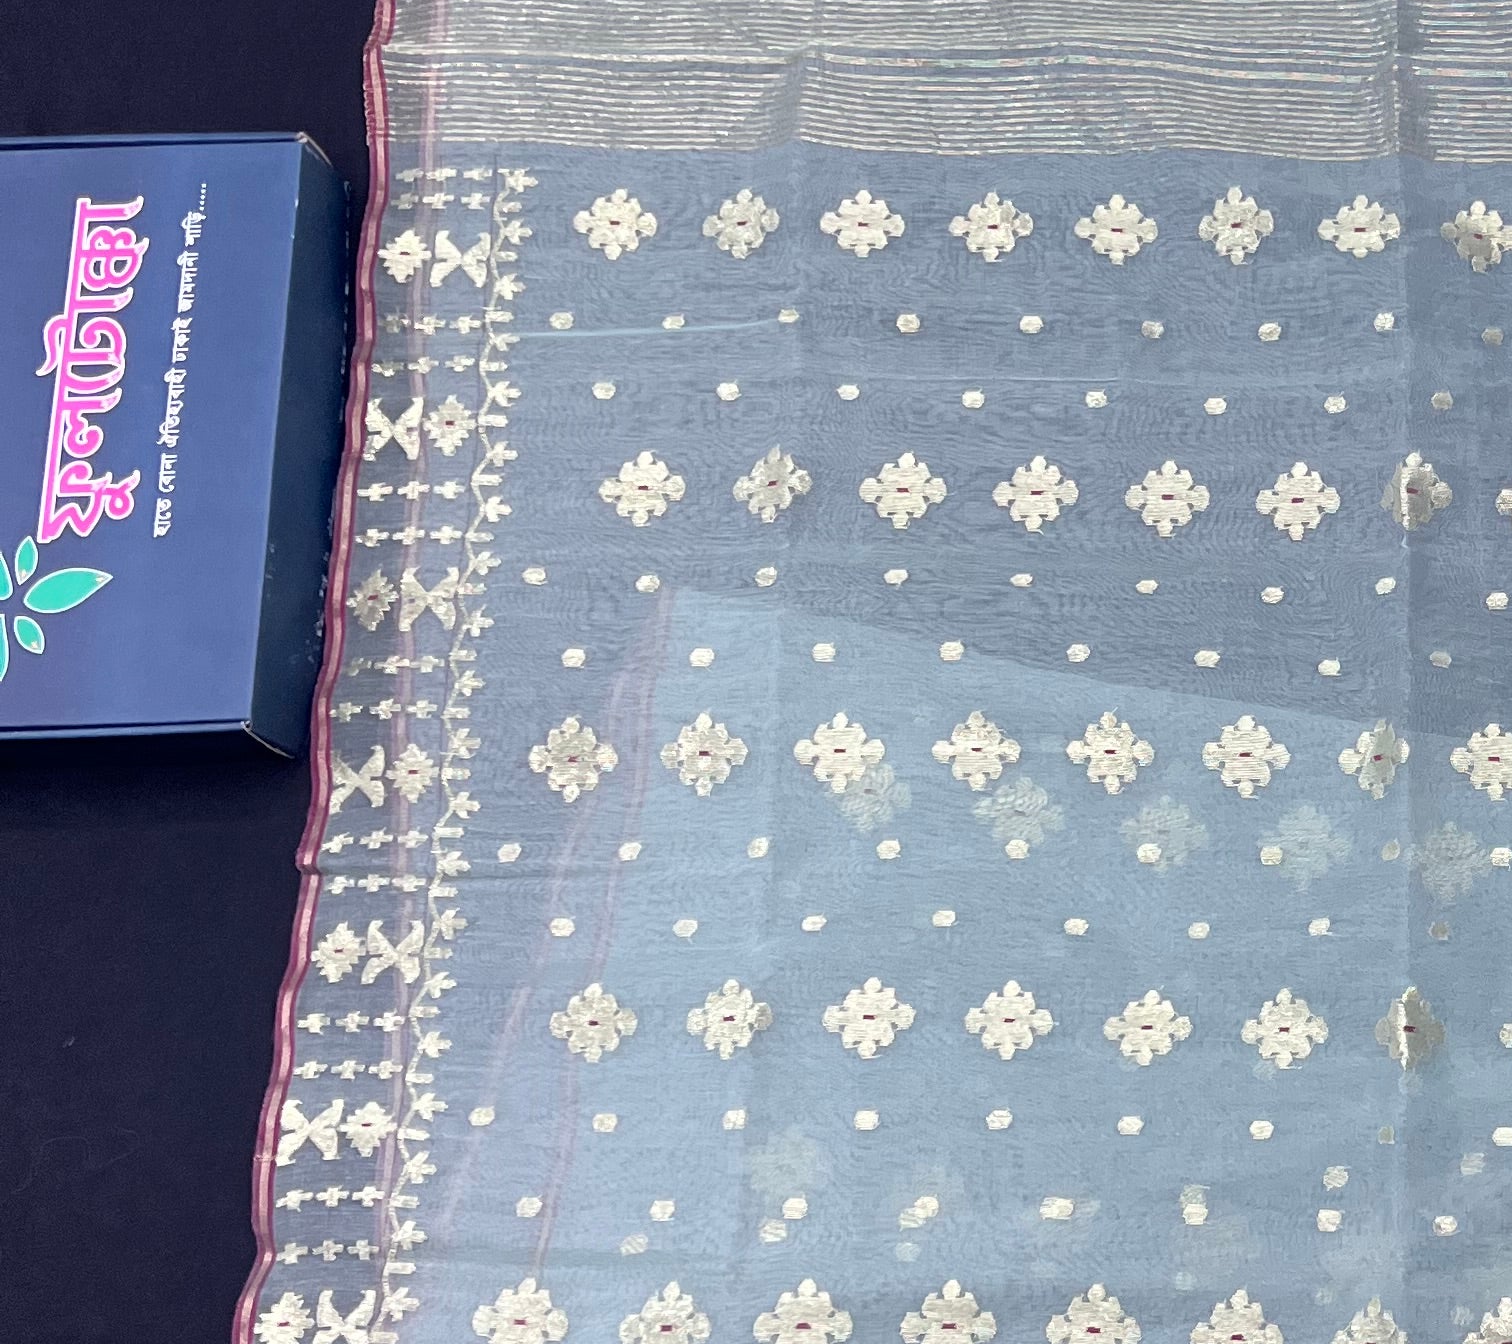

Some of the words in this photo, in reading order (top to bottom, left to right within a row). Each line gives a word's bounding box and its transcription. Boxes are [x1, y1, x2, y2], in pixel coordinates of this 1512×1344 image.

[170, 315, 193, 365] ঢাকাই
[158, 451, 178, 495] বোনা
[153, 495, 174, 538] হাতে
